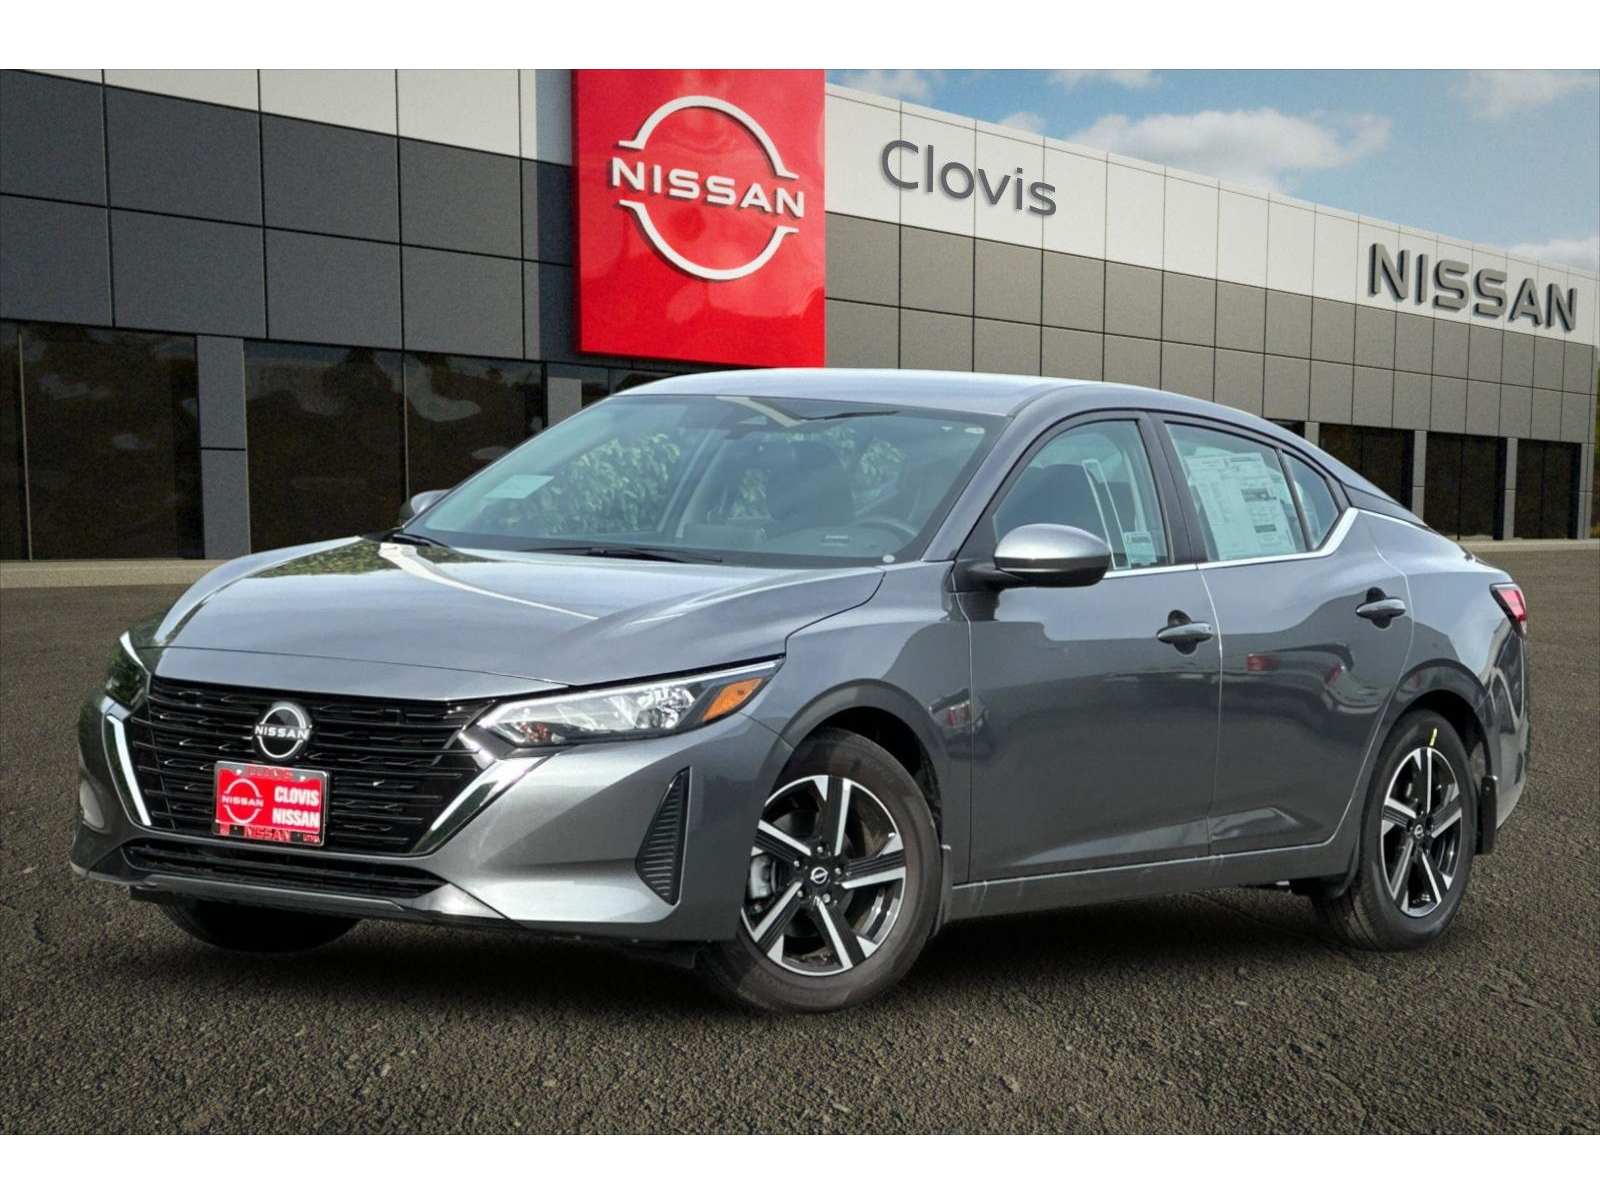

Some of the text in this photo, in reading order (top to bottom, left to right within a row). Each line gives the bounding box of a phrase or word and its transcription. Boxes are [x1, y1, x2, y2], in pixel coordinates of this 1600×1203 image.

[611, 156, 805, 218] NISSAN
[881, 139, 1057, 216] Clovis
[1368, 242, 1578, 332] NISSAN
[254, 725, 310, 741] NISSAN
[221, 794, 263, 808] NISSAN
[274, 785, 319, 806] CLOVIS
[272, 808, 320, 828] NISSAN
